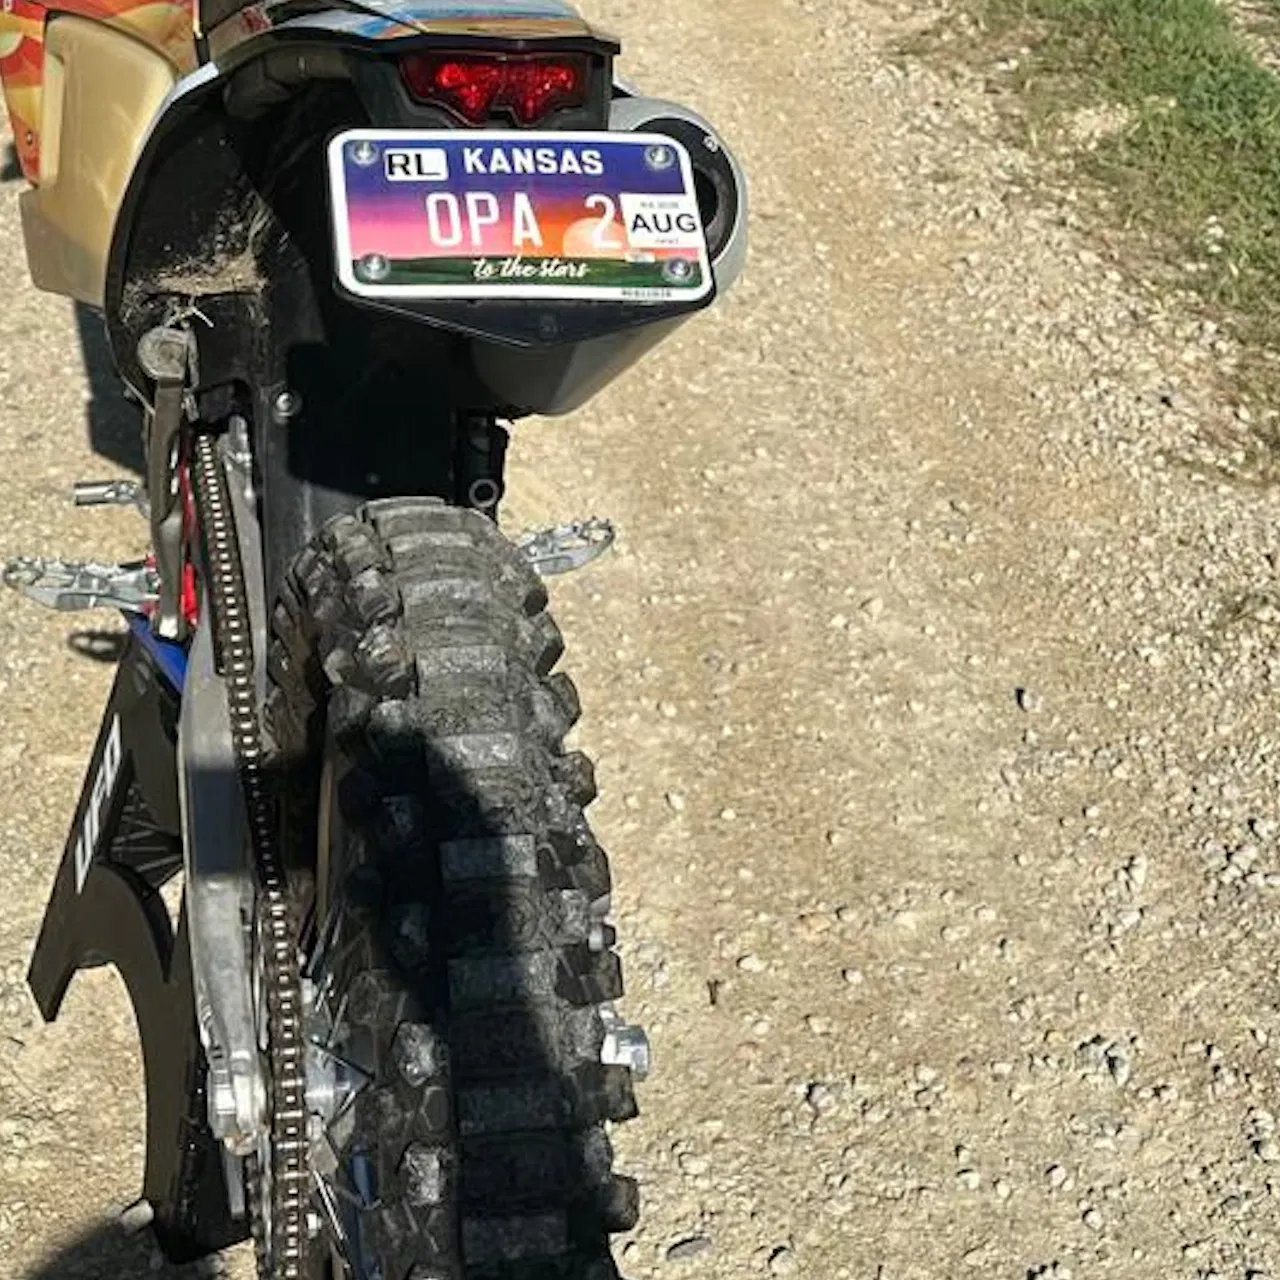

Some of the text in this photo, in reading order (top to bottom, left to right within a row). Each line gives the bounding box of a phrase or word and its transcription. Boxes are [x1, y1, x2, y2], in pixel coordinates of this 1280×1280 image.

[387, 153, 441, 176] RL
[463, 147, 604, 175] KANSAS
[632, 213, 697, 233] AUG
[472, 253, 591, 278] to the stars
[75, 712, 121, 895] UFO
